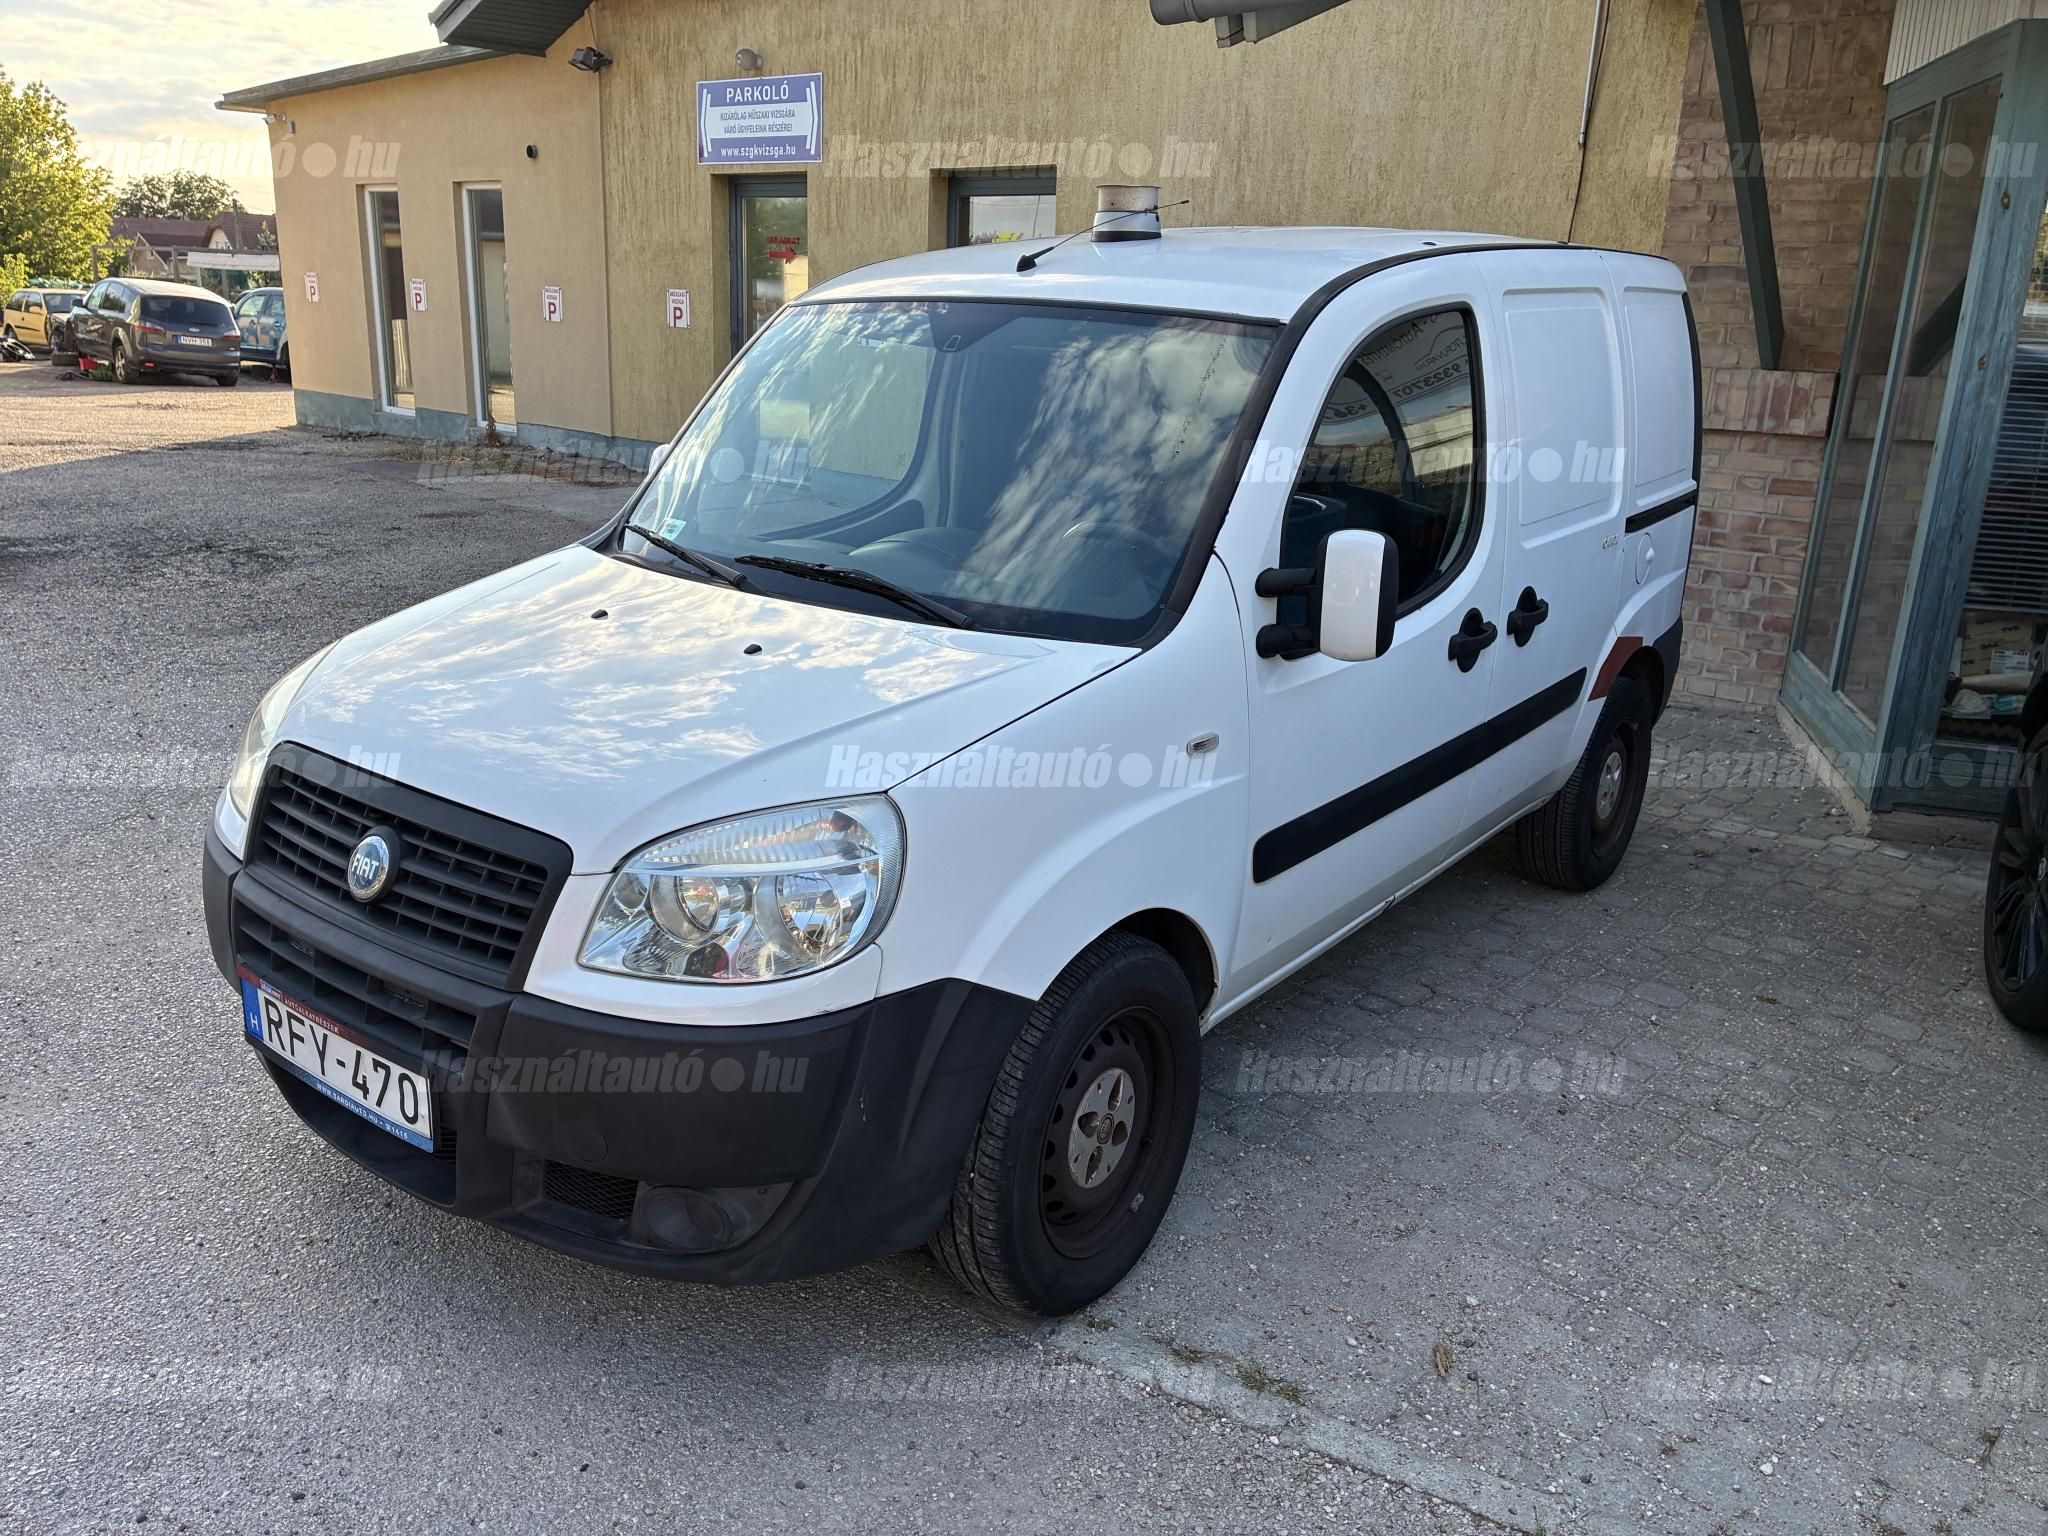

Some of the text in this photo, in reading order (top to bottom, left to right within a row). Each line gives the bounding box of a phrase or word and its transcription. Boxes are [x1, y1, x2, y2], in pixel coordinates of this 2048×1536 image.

[726, 80, 789, 103] PARKOLÓ
[720, 107, 796, 121] KIZÁRÓLAG MŰSZAKI VIZSGÁRA
[724, 124, 737, 135] VÁRÓ
[720, 143, 796, 159] www.szgkvizsga.hu
[309, 285, 316, 302] P
[415, 292, 422, 310] P
[548, 301, 557, 321] P
[673, 306, 684, 328] P
[351, 852, 380, 880] FIAT
[249, 1011, 260, 1032] H
[263, 995, 420, 1126] RFY-470
